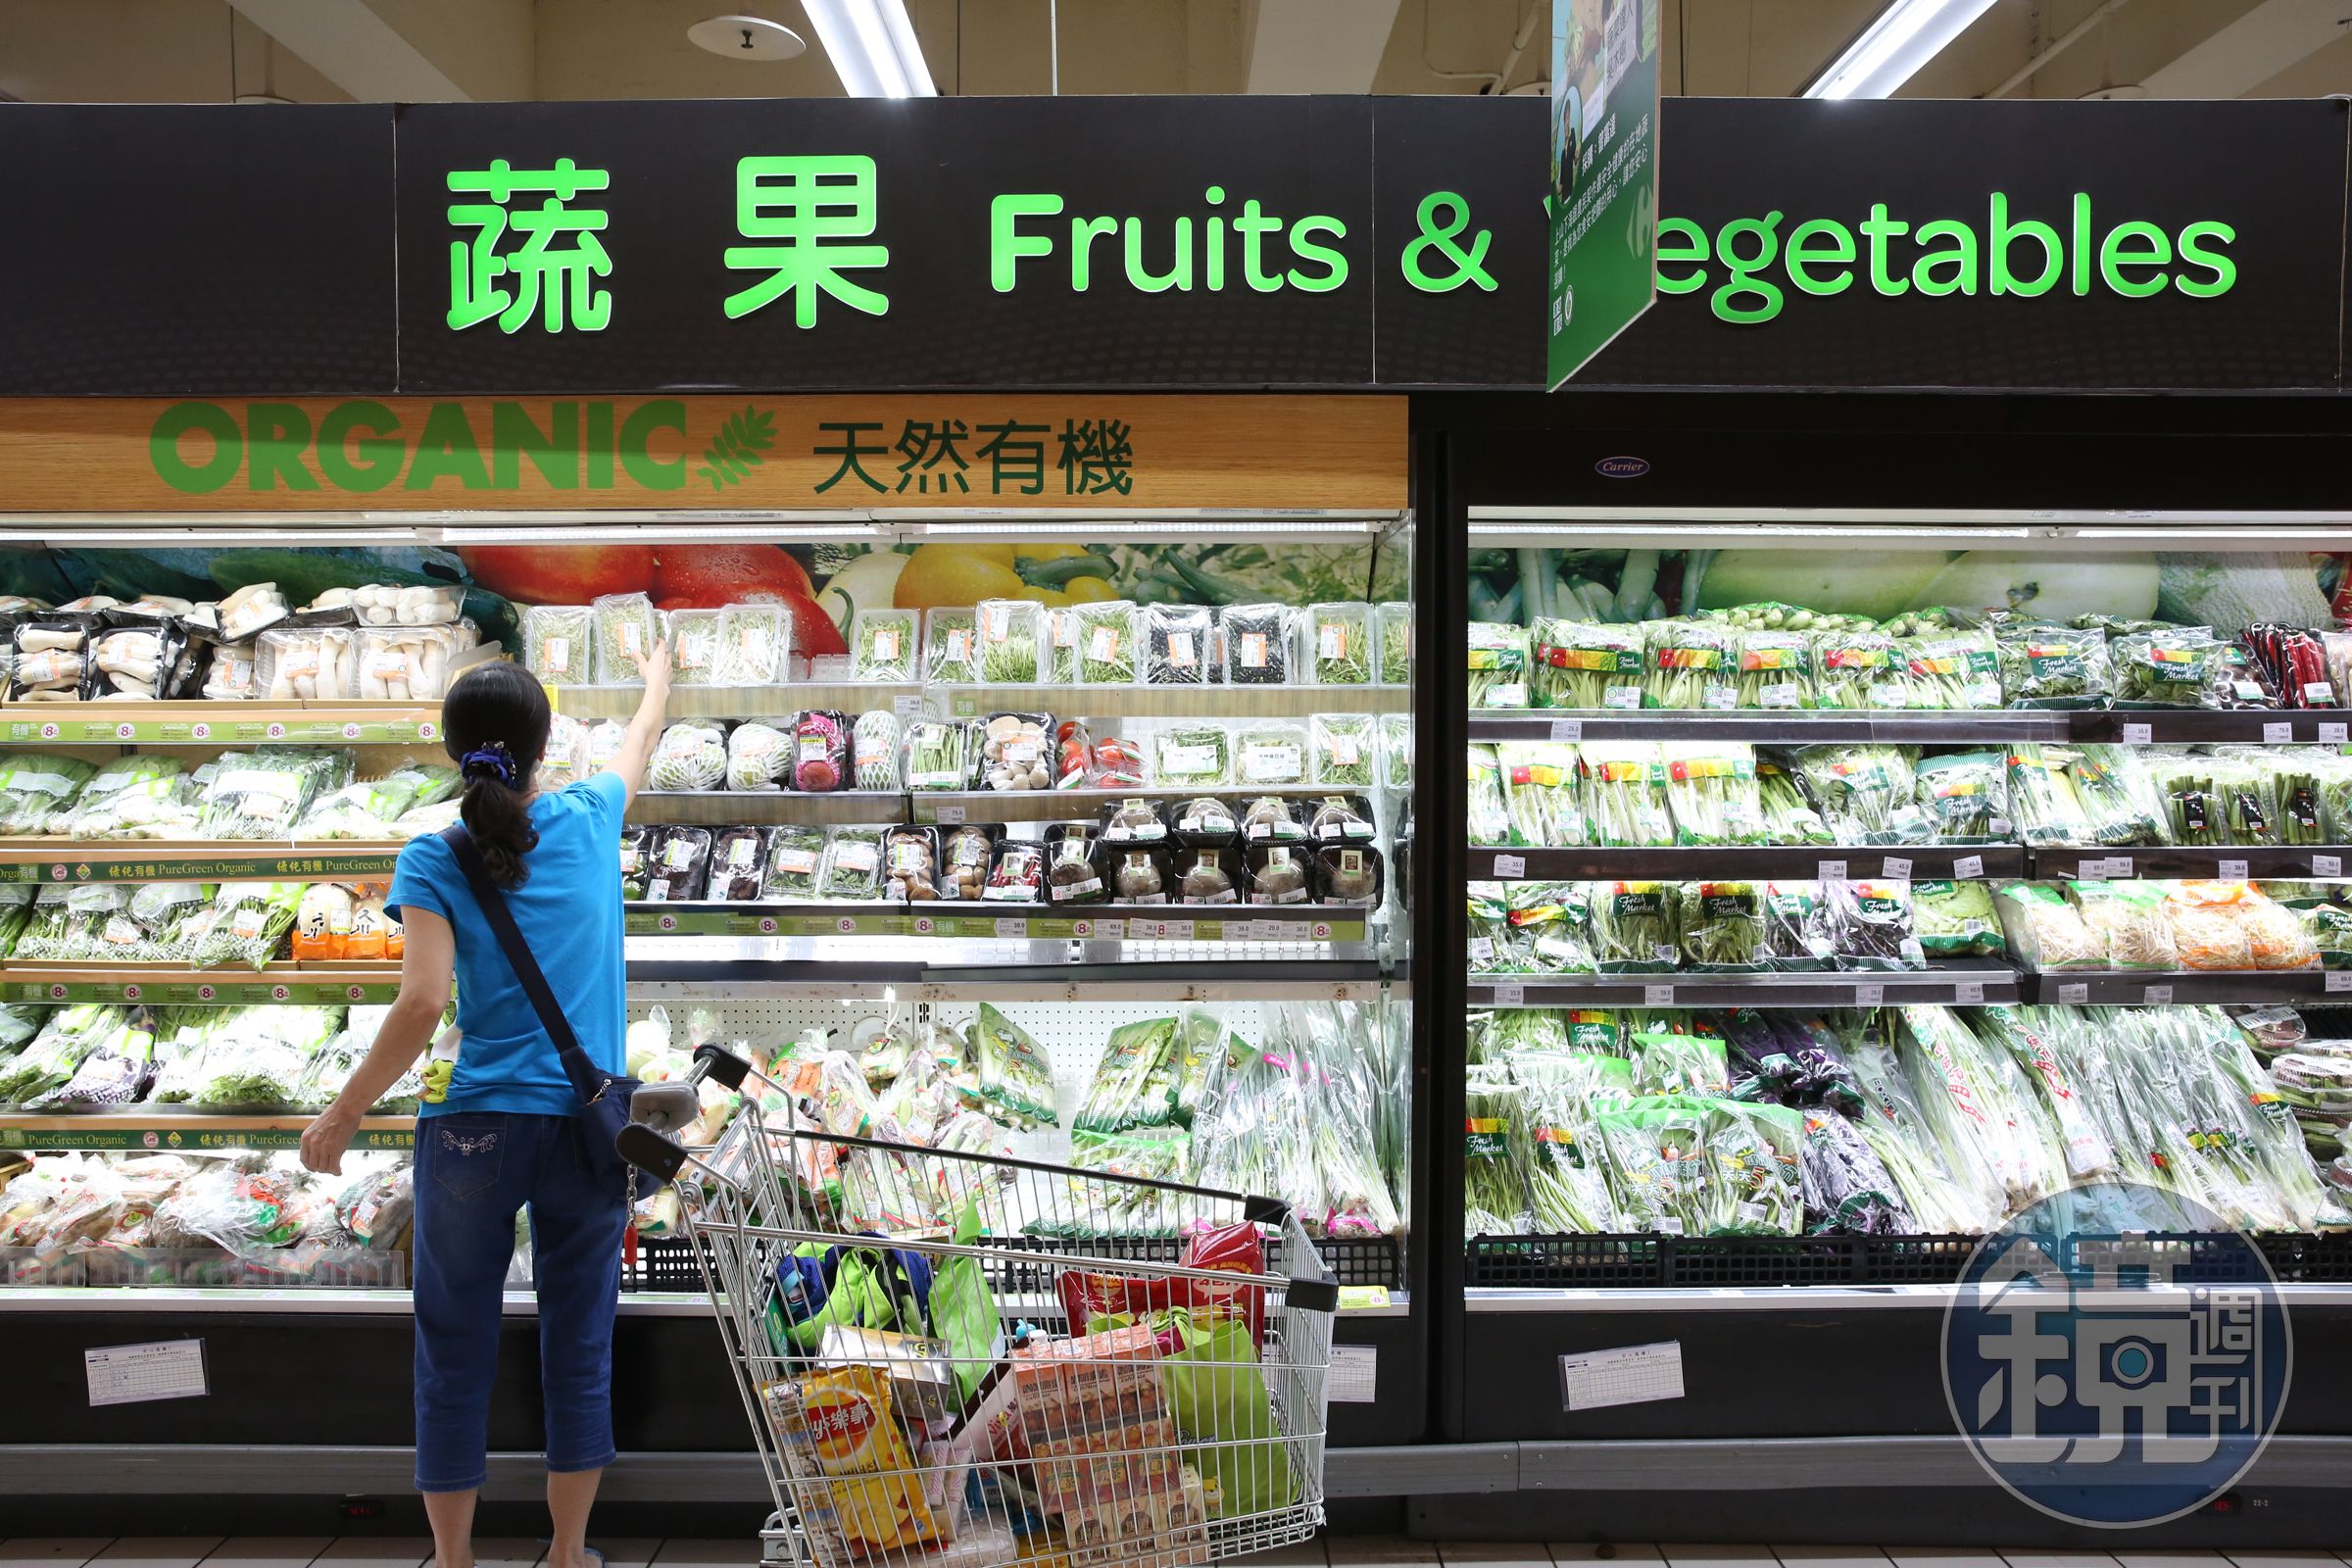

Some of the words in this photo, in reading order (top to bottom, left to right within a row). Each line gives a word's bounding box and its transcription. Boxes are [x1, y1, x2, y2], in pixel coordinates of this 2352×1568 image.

[990, 185, 1349, 293] Fruits
[1400, 191, 1498, 293] &
[1544, 191, 2237, 323] egetables
[149, 399, 687, 495] ORGANIC
[811, 417, 1134, 496] 天然有機
[1602, 462, 1643, 471] Carrier
[2038, 656, 2067, 667] Fresh
[2161, 662, 2191, 672] Fresh
[2044, 663, 2078, 675] Market
[2164, 669, 2199, 680] Market
[1944, 797, 1972, 808] Fresh
[1948, 806, 1983, 816] Market
[159, 864, 214, 874] PureGreen
[216, 862, 256, 874] Organic
[325, 859, 381, 870] PureGreen
[1619, 896, 1645, 906] Fresh
[1710, 897, 1737, 906] Fresh
[1624, 904, 1655, 915] Market
[1713, 906, 1746, 915] Market
[1575, 1024, 1599, 1034] Fresh
[28, 1135, 84, 1145] PureGreen
[85, 1134, 126, 1146] Organic
[250, 1134, 301, 1145] PureGree
[1467, 1135, 1494, 1146] Fresh
[1472, 1144, 1503, 1154] Market
